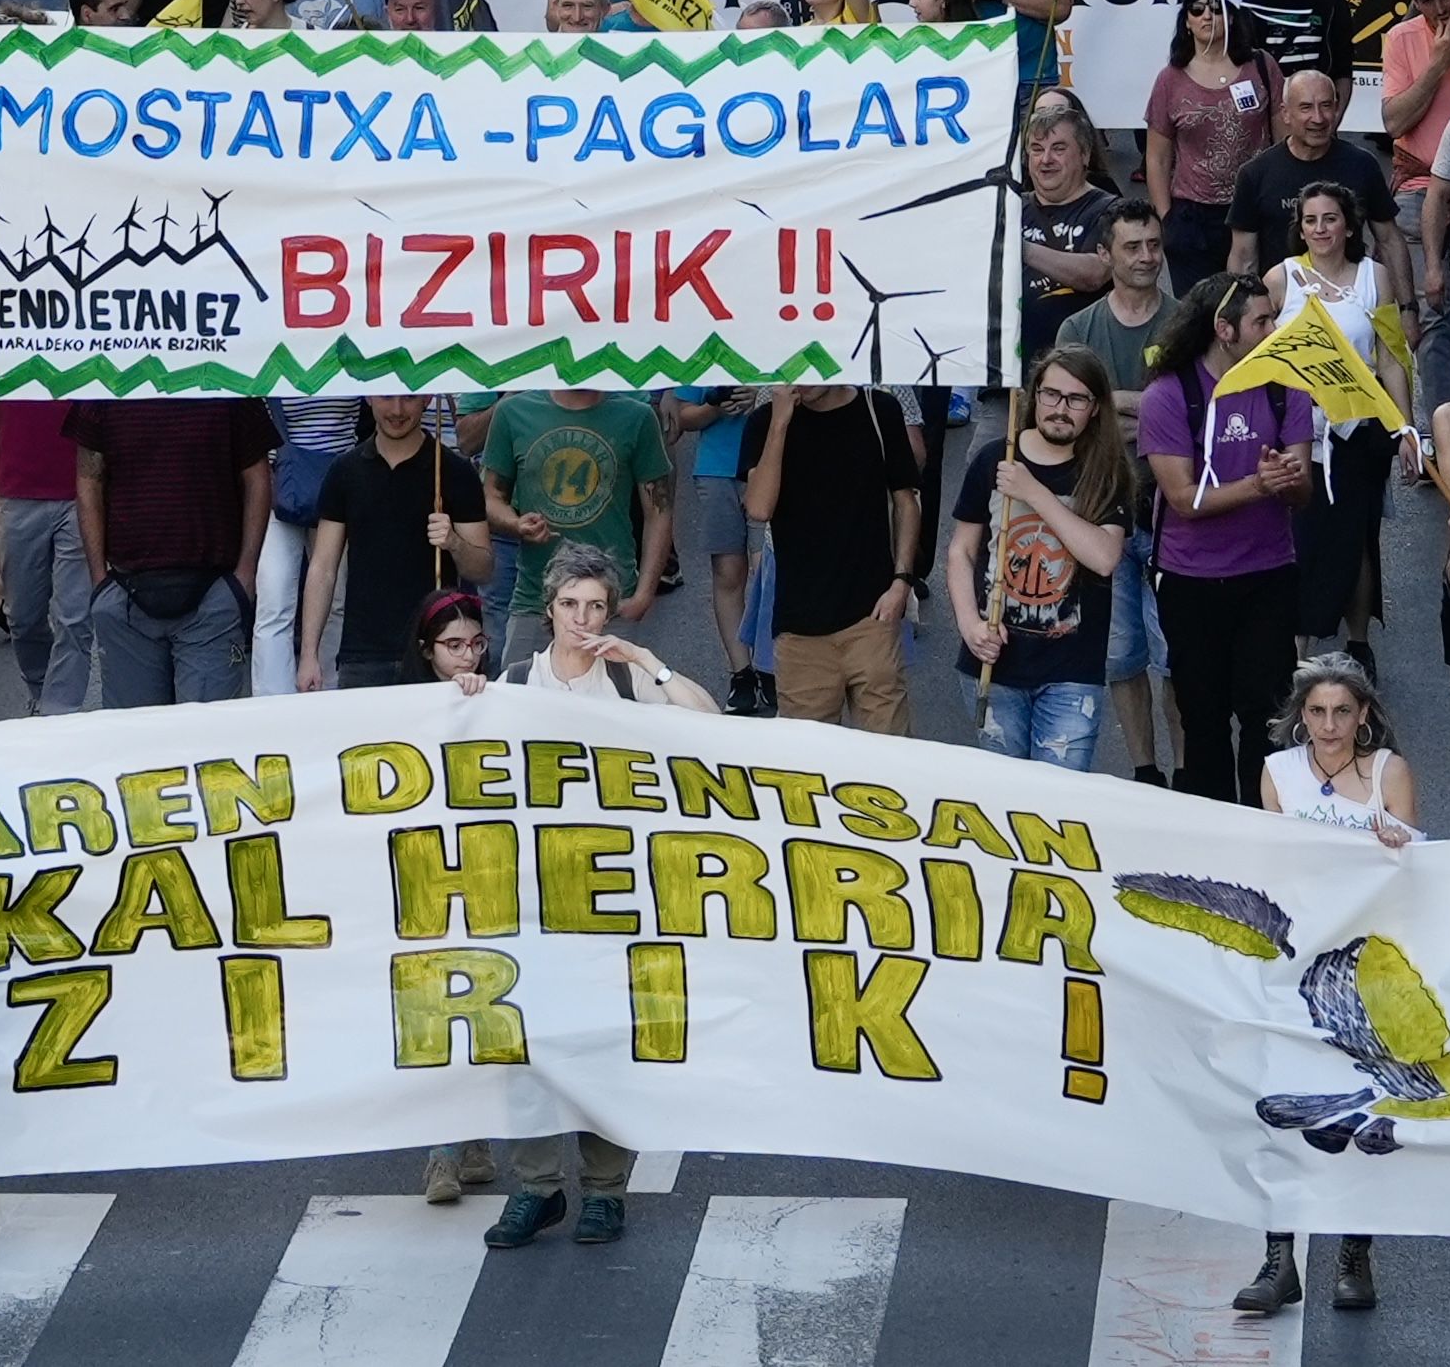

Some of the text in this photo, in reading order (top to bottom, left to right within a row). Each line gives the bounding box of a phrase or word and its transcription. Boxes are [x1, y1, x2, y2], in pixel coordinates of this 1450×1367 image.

[197, 292, 242, 336] EZ
[280, 227, 836, 330] BIZIRIK !!
[89, 337, 163, 352] MENDIAK
[167, 337, 228, 353] BIZIRIK
[551, 460, 591, 497] 14
[339, 739, 1102, 873] DEFENTSAN
[388, 820, 1106, 976] HERRIA
